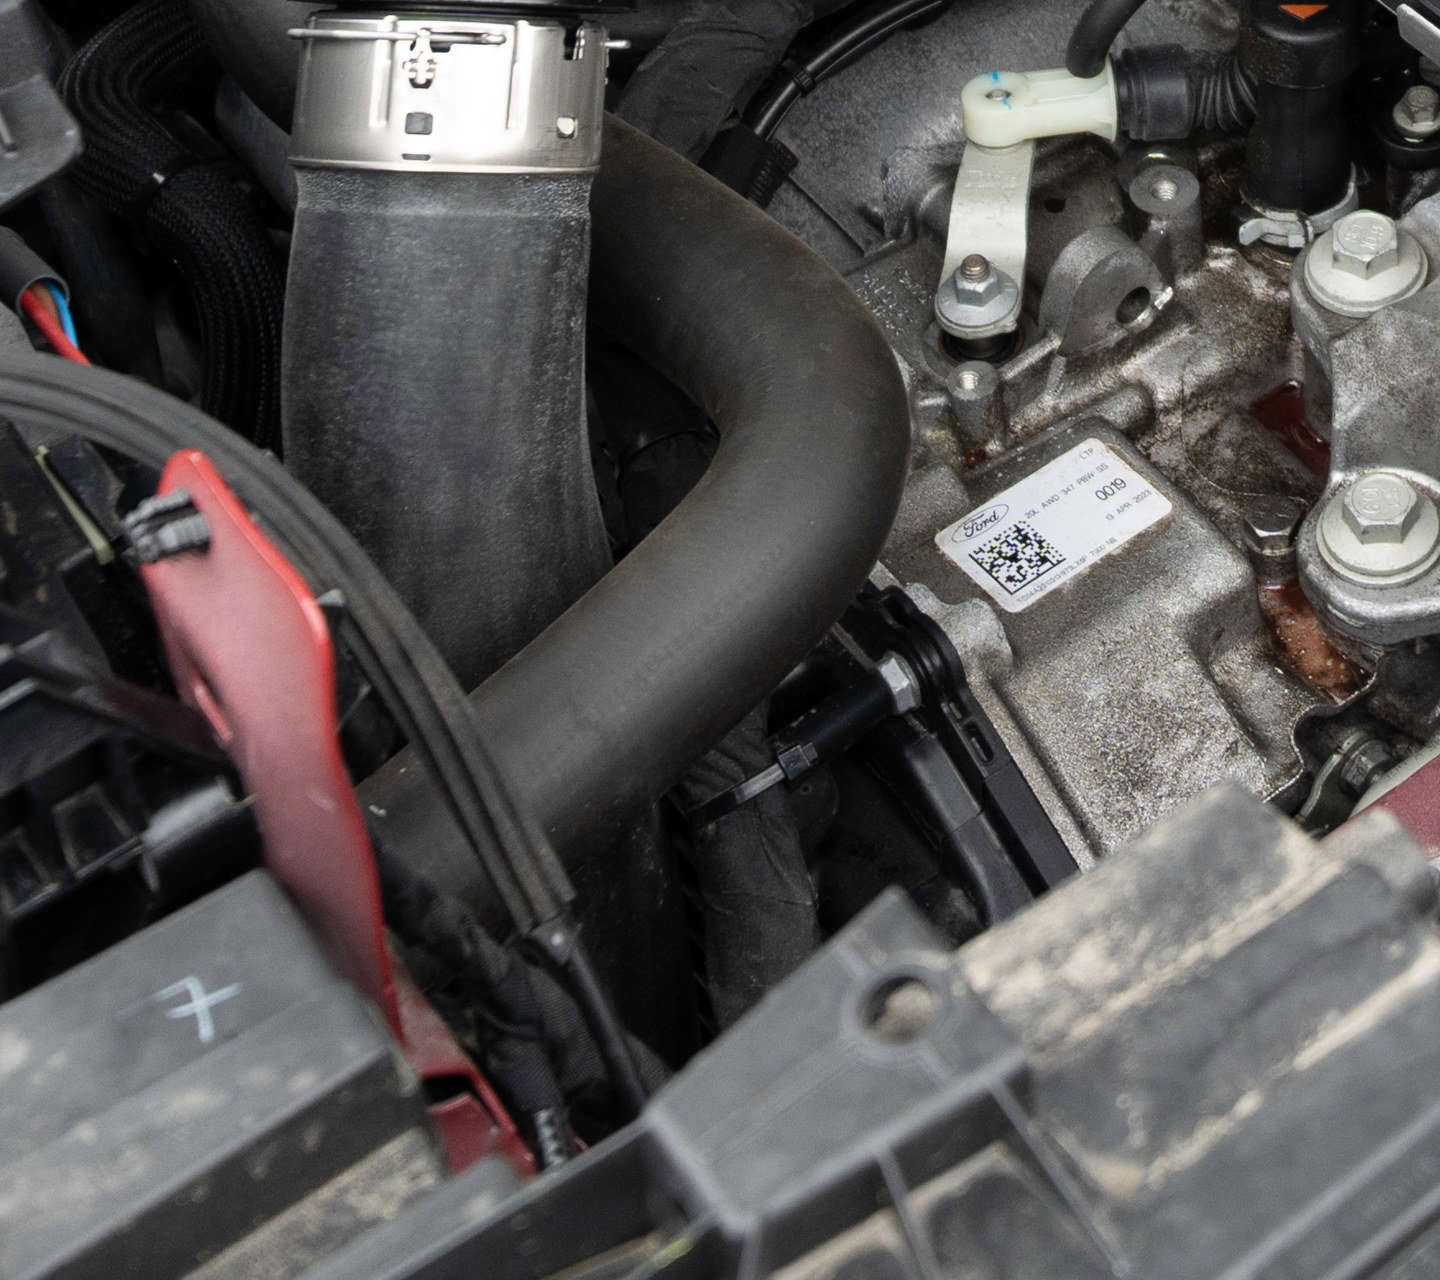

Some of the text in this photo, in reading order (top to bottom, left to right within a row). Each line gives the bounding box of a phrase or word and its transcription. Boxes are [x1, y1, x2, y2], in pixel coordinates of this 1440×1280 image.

[1040, 492, 1061, 509] AWD
[1076, 470, 1095, 486] PBW
[1095, 476, 1126, 502] 0019
[1115, 500, 1132, 515] APR
[1133, 488, 1152, 503] 2023
[960, 506, 999, 537] Ford
